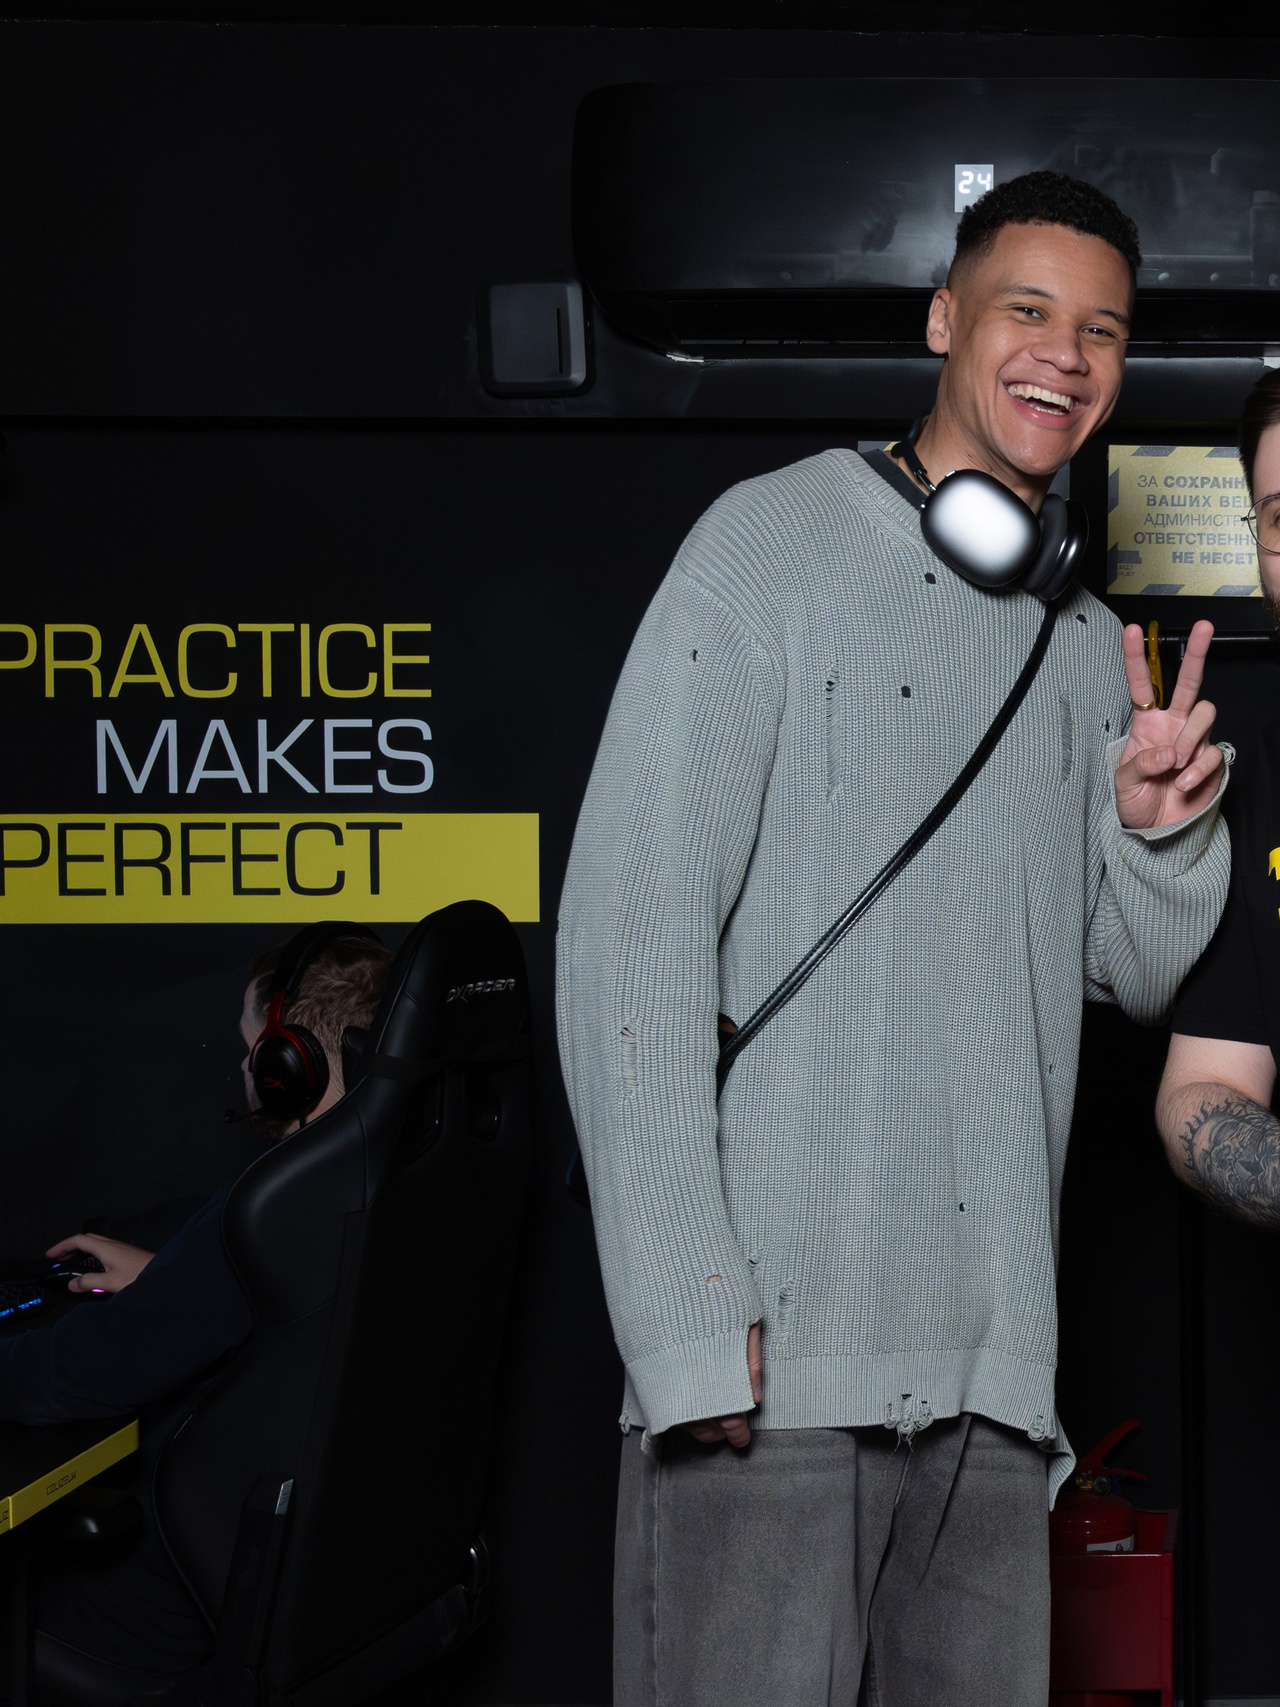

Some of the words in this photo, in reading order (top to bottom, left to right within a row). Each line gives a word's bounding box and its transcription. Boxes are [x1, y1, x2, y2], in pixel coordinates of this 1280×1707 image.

[958, 171, 992, 194] 24
[1137, 475, 1158, 488] ЗА
[1164, 475, 1247, 489] СОХРАНН
[1146, 495, 1212, 507] ВАШИХ
[1172, 551, 1194, 564] НЕ
[1200, 552, 1255, 565] НЕСЕТ
[0, 623, 432, 698] PRACTICE
[96, 718, 435, 794] MAKES
[0, 822, 403, 896] PERFECT
